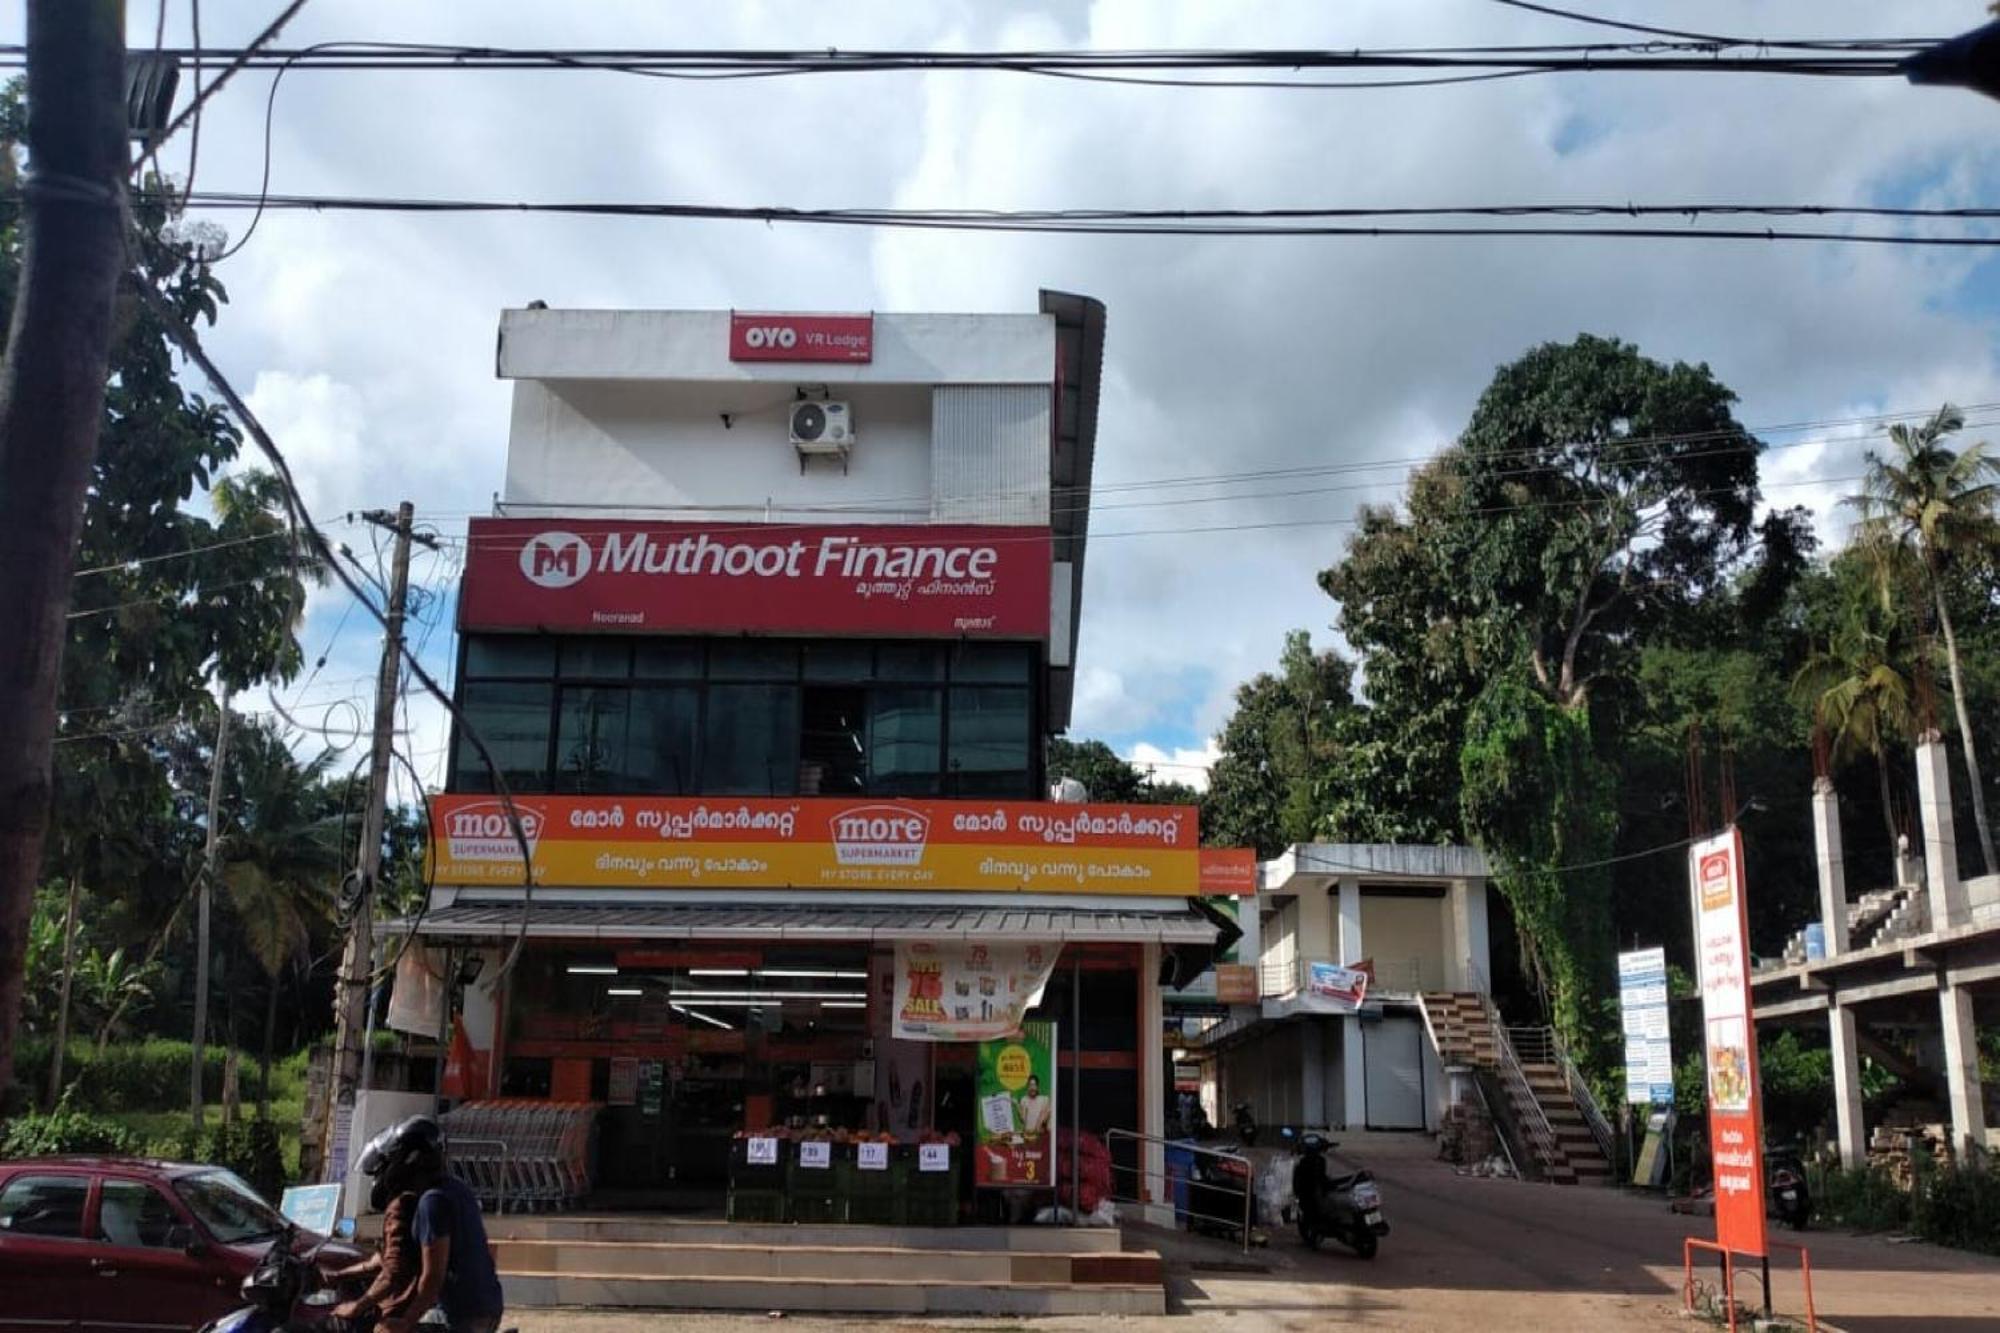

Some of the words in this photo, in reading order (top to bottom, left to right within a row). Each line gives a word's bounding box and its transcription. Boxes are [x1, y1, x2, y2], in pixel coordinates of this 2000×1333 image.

[745, 327, 797, 349] OYO
[805, 333, 824, 345] VR
[826, 333, 866, 348] Lodge
[600, 532, 804, 578] Muthoot
[813, 536, 998, 580] Finance
[452, 813, 538, 837] more
[570, 805, 625, 828] മോർ
[953, 810, 1008, 831] മോർ
[838, 818, 923, 841] more
[841, 848, 918, 859] SUPERMARKET
[904, 998, 940, 1014] SALE
